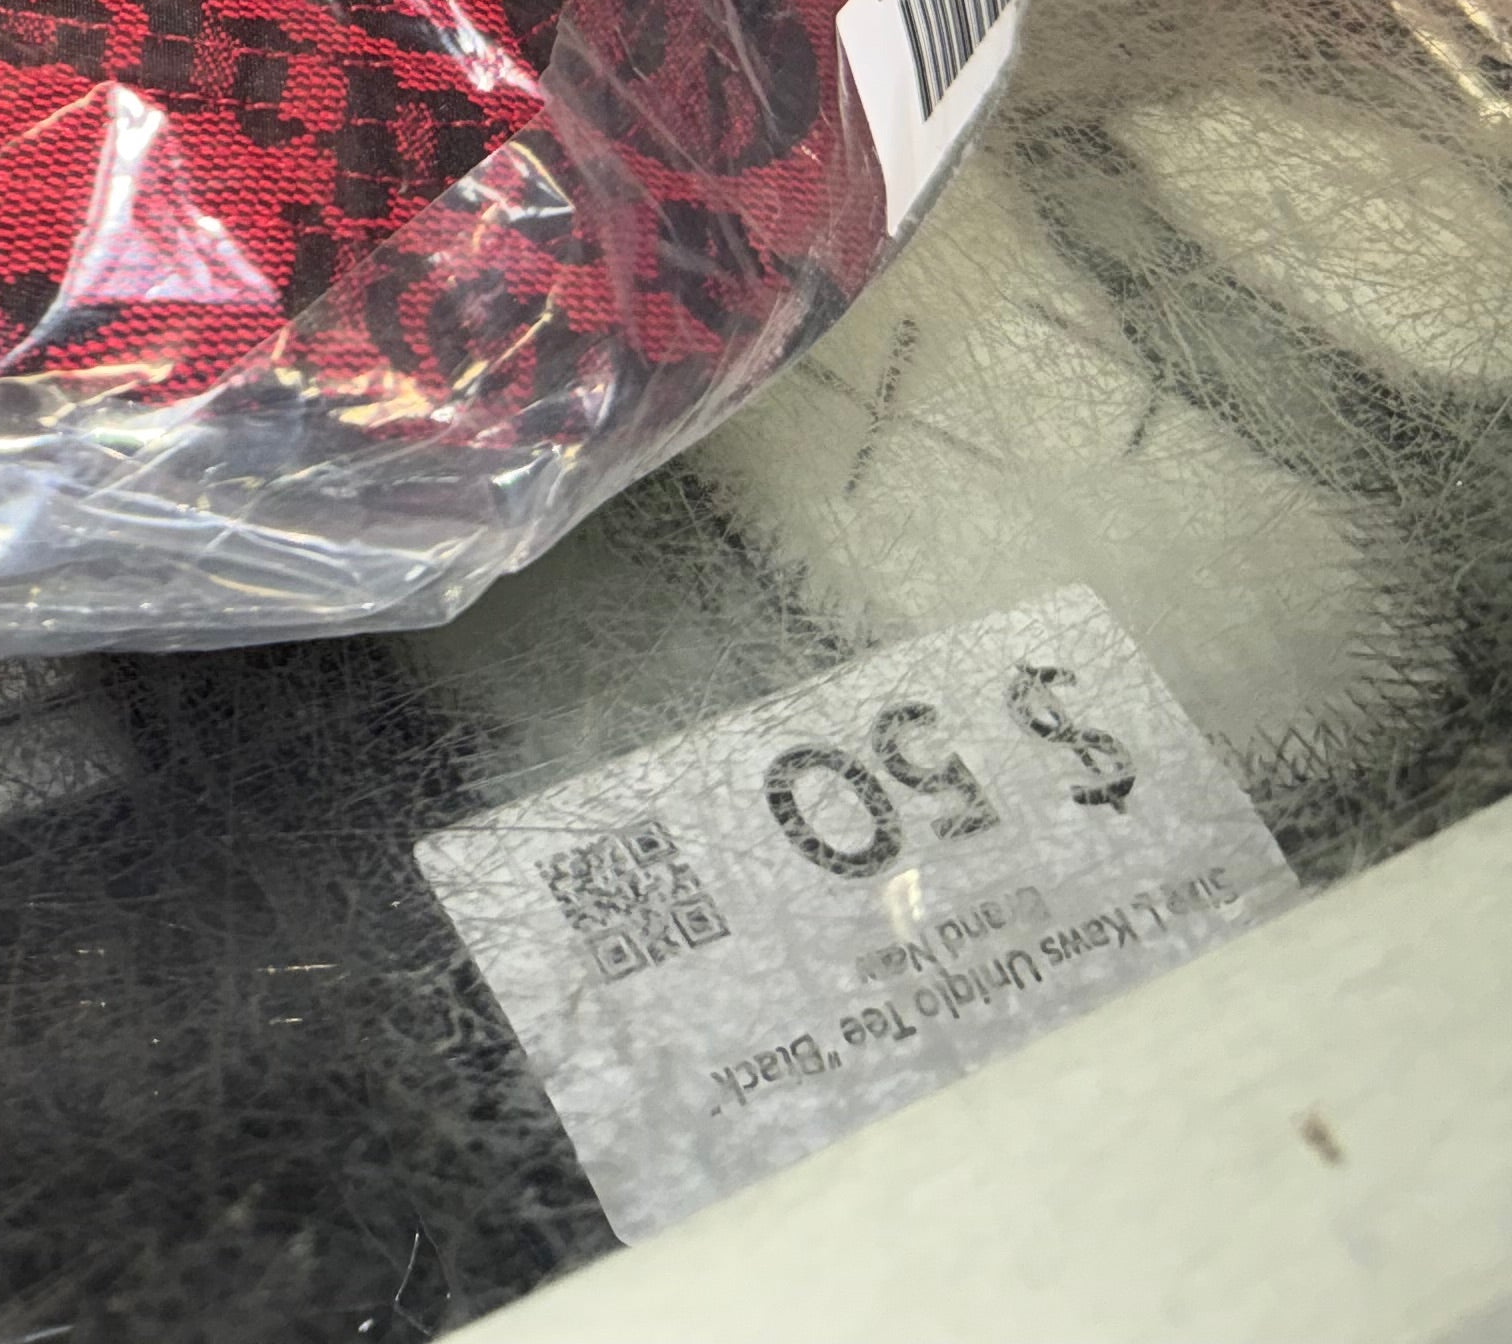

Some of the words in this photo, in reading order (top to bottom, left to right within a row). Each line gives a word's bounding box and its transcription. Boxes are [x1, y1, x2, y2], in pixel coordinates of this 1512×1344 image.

[763, 701, 1001, 878] 50
[1040, 907, 1140, 966] Kaws
[914, 948, 1043, 1019] Uniqlo
[839, 1000, 918, 1047] Tee
